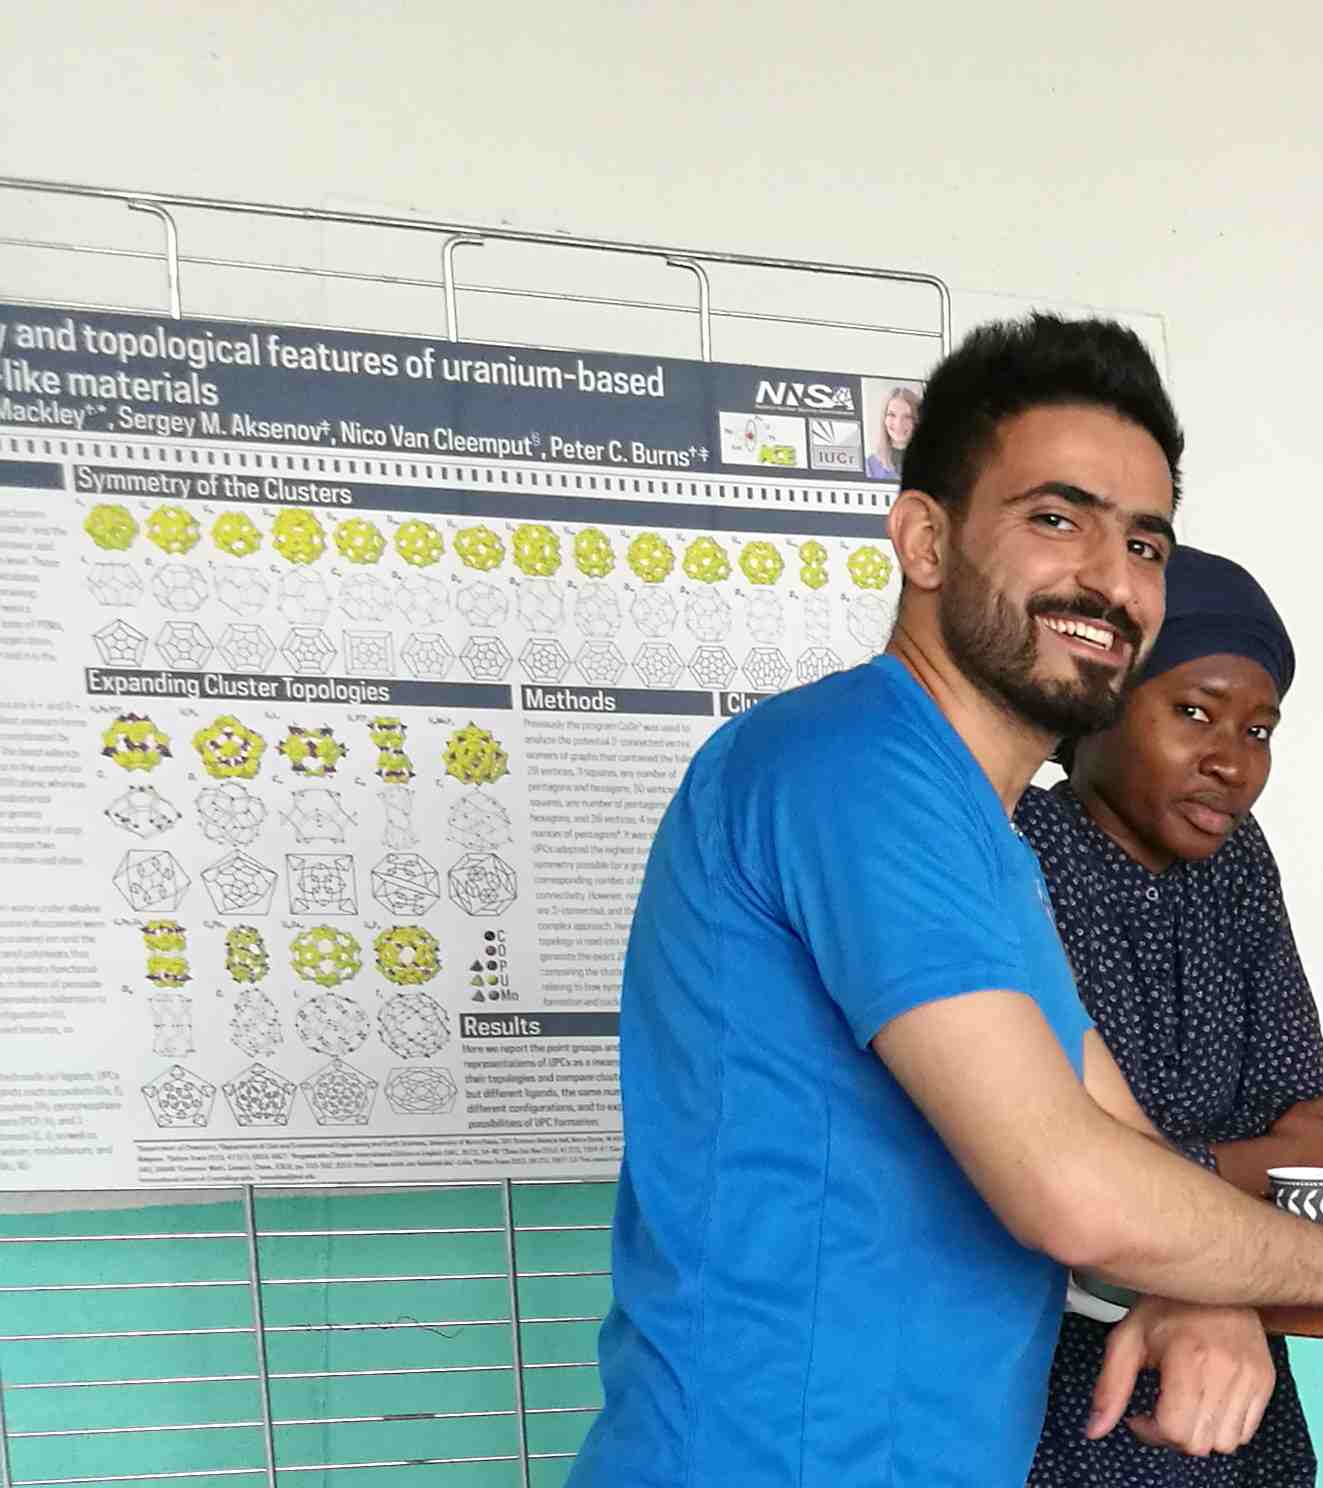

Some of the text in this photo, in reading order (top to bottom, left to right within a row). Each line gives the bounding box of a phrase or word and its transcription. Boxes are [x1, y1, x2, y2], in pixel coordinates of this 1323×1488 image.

[16, 317, 77, 352] and
[81, 322, 261, 369] topological
[267, 334, 399, 377] features
[405, 347, 436, 379] of
[442, 354, 665, 397] uranium-based
[66, 370, 219, 406] materials
[119, 404, 196, 438] Sergey
[200, 410, 227, 436] M.
[340, 420, 387, 446] Nico
[389, 423, 430, 450] Van
[551, 435, 605, 461] Peter
[609, 440, 629, 463] C.
[819, 450, 856, 465] IUCr
[78, 465, 352, 504] Symmetry of the Clusters
[88, 668, 391, 705] Expanding Cluster Topologies
[525, 687, 617, 711] Methods
[463, 1015, 541, 1036] Results
